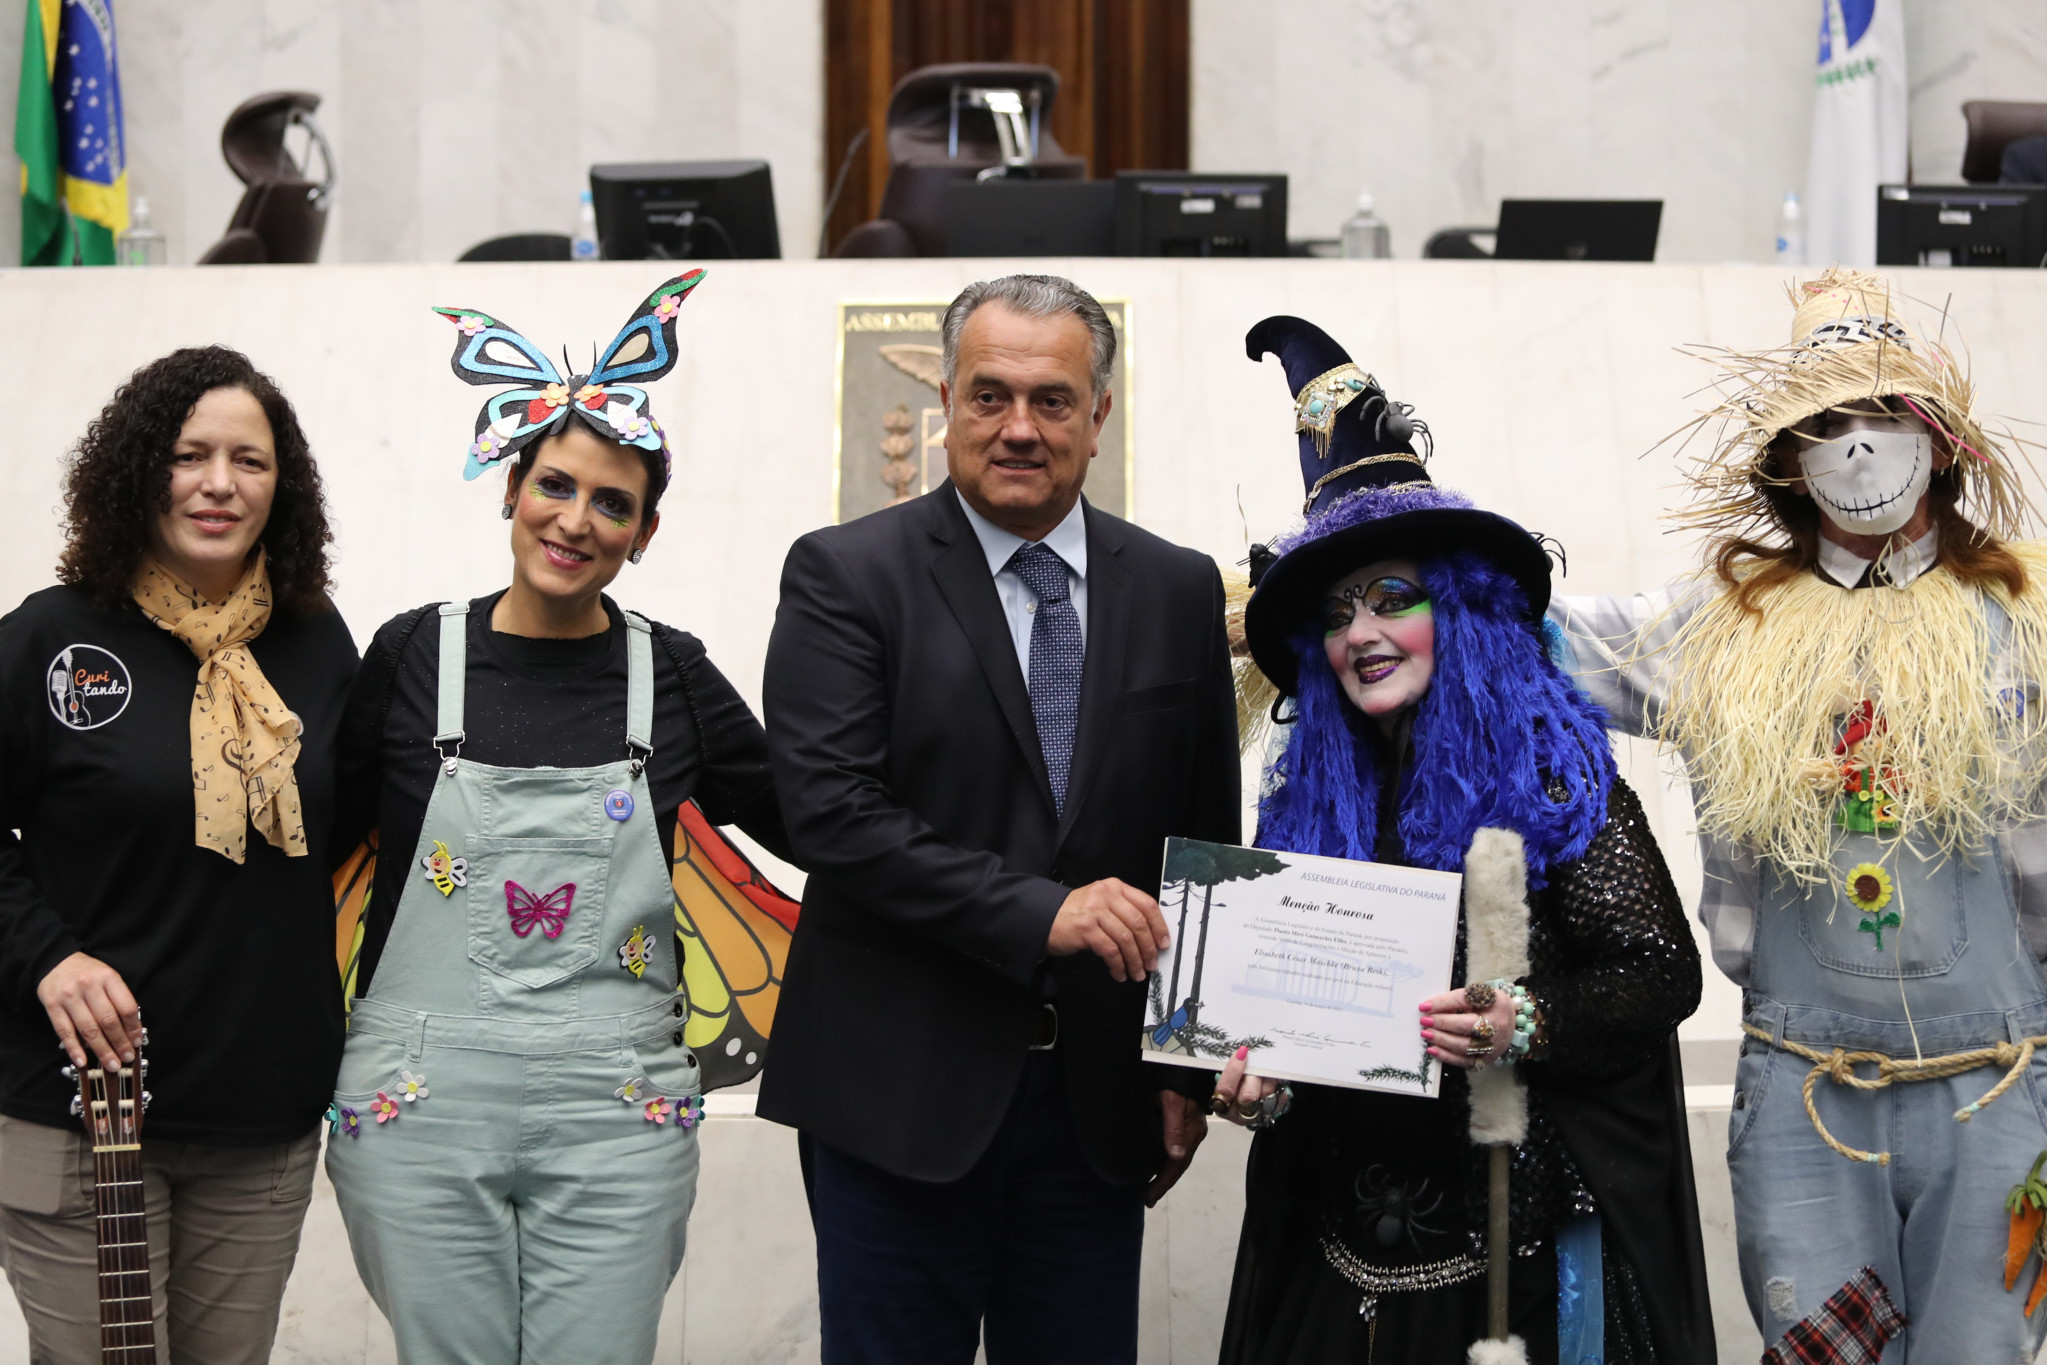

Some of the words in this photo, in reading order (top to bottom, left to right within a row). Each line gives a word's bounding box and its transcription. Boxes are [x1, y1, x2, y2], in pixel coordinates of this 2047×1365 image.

[845, 312, 941, 332] ASSEMBL
[75, 669, 110, 686] Curi
[83, 680, 127, 696] tando
[1301, 872, 1349, 887] ASSEMBLEIA
[1350, 881, 1399, 895] LEGISLATIVA
[1399, 887, 1413, 897] DO
[1414, 889, 1447, 902] PARANÁ
[1277, 895, 1320, 913] Menção
[1324, 902, 1374, 921] Honrosa
